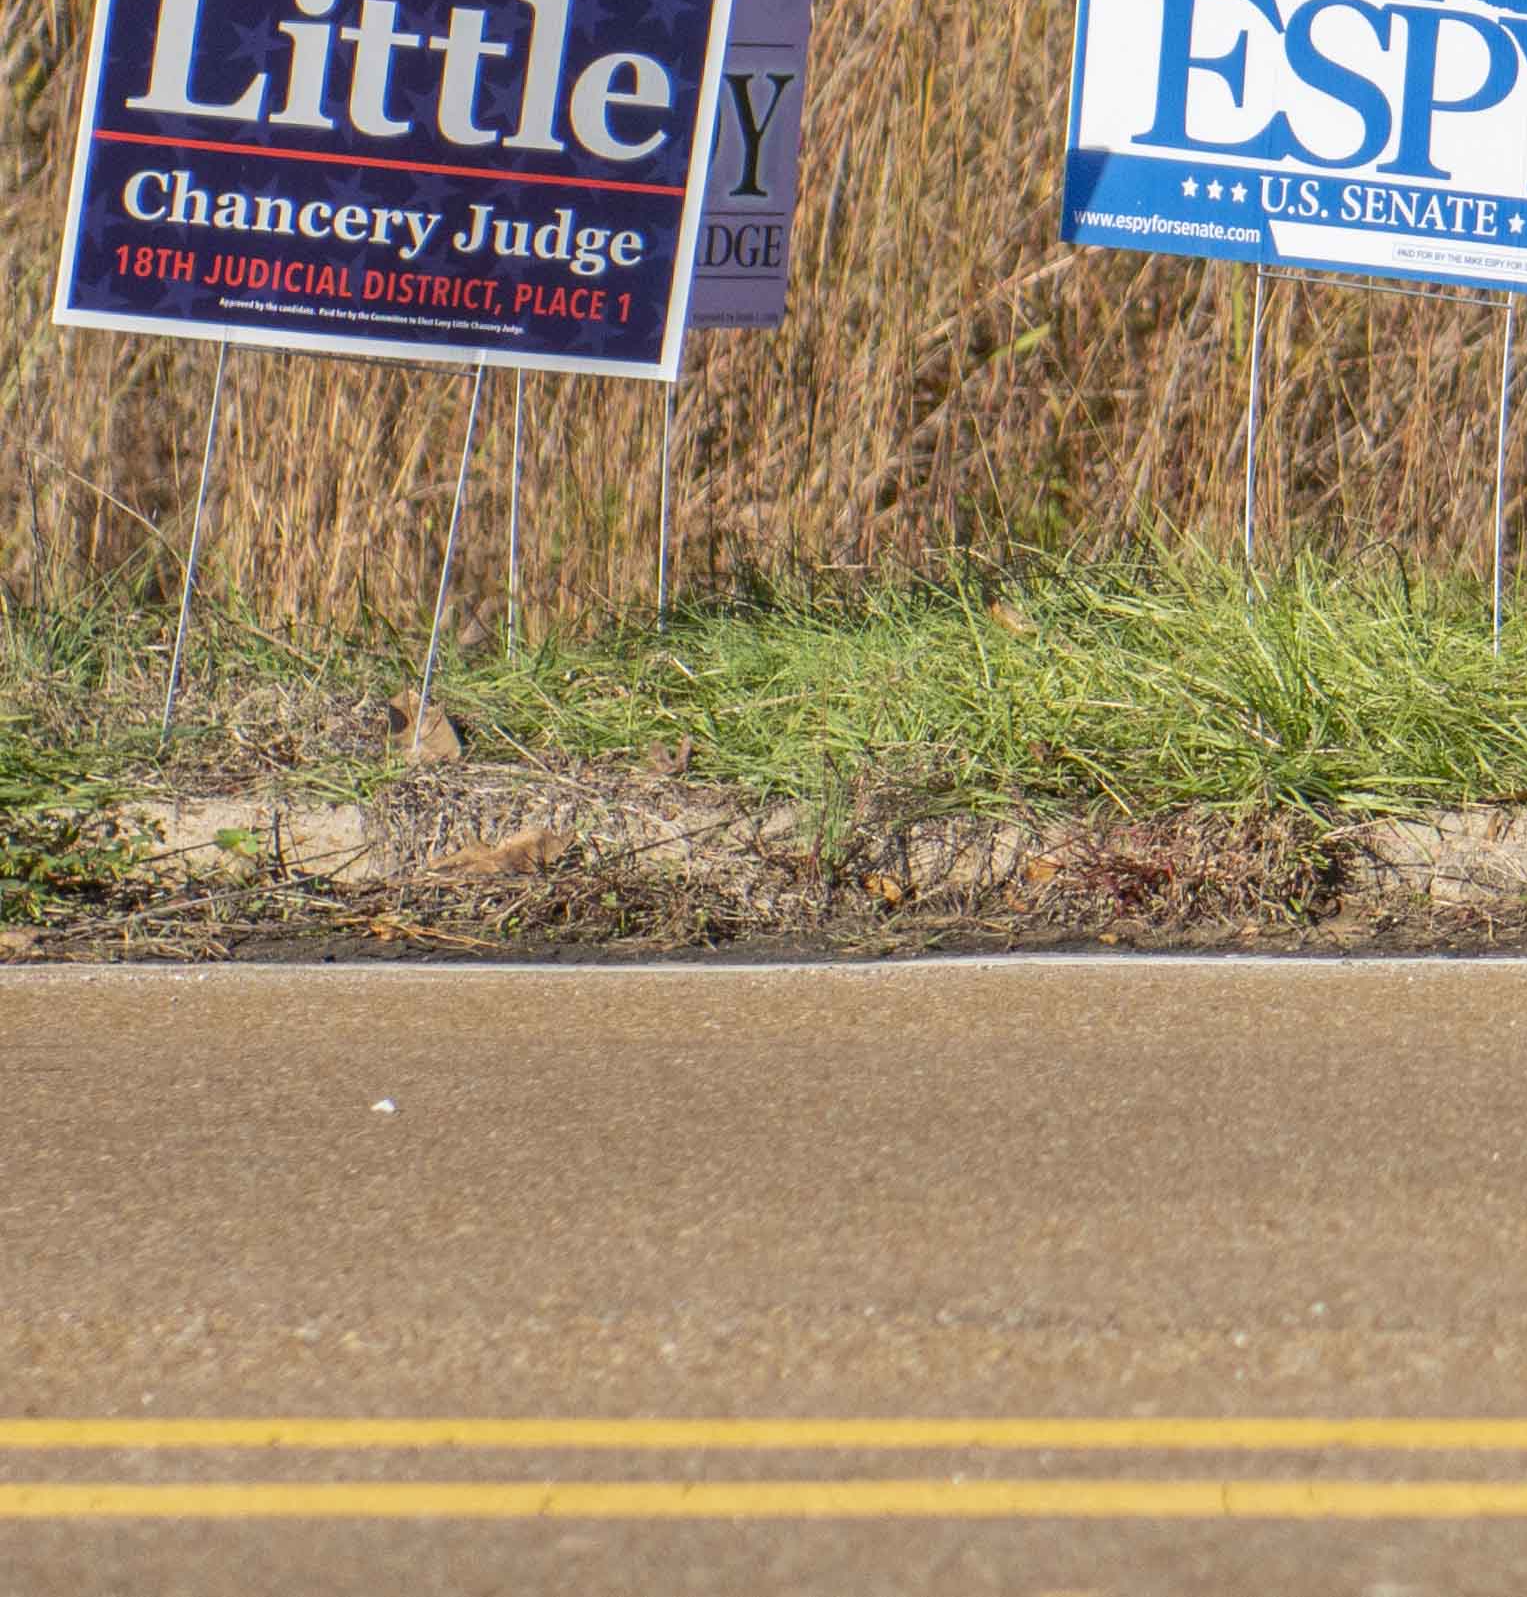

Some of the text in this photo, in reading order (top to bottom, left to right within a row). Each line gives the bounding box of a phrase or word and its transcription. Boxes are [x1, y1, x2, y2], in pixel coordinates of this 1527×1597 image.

[123, 170, 643, 276] Chancery Judge
[1073, 208, 1261, 243] www.espyforsenate.com
[1260, 174, 1498, 237] U.S. SENATE
[699, 223, 783, 268] DGE
[115, 244, 631, 323] 18TH JUDICIAL DISTRICT, PLACE 1
